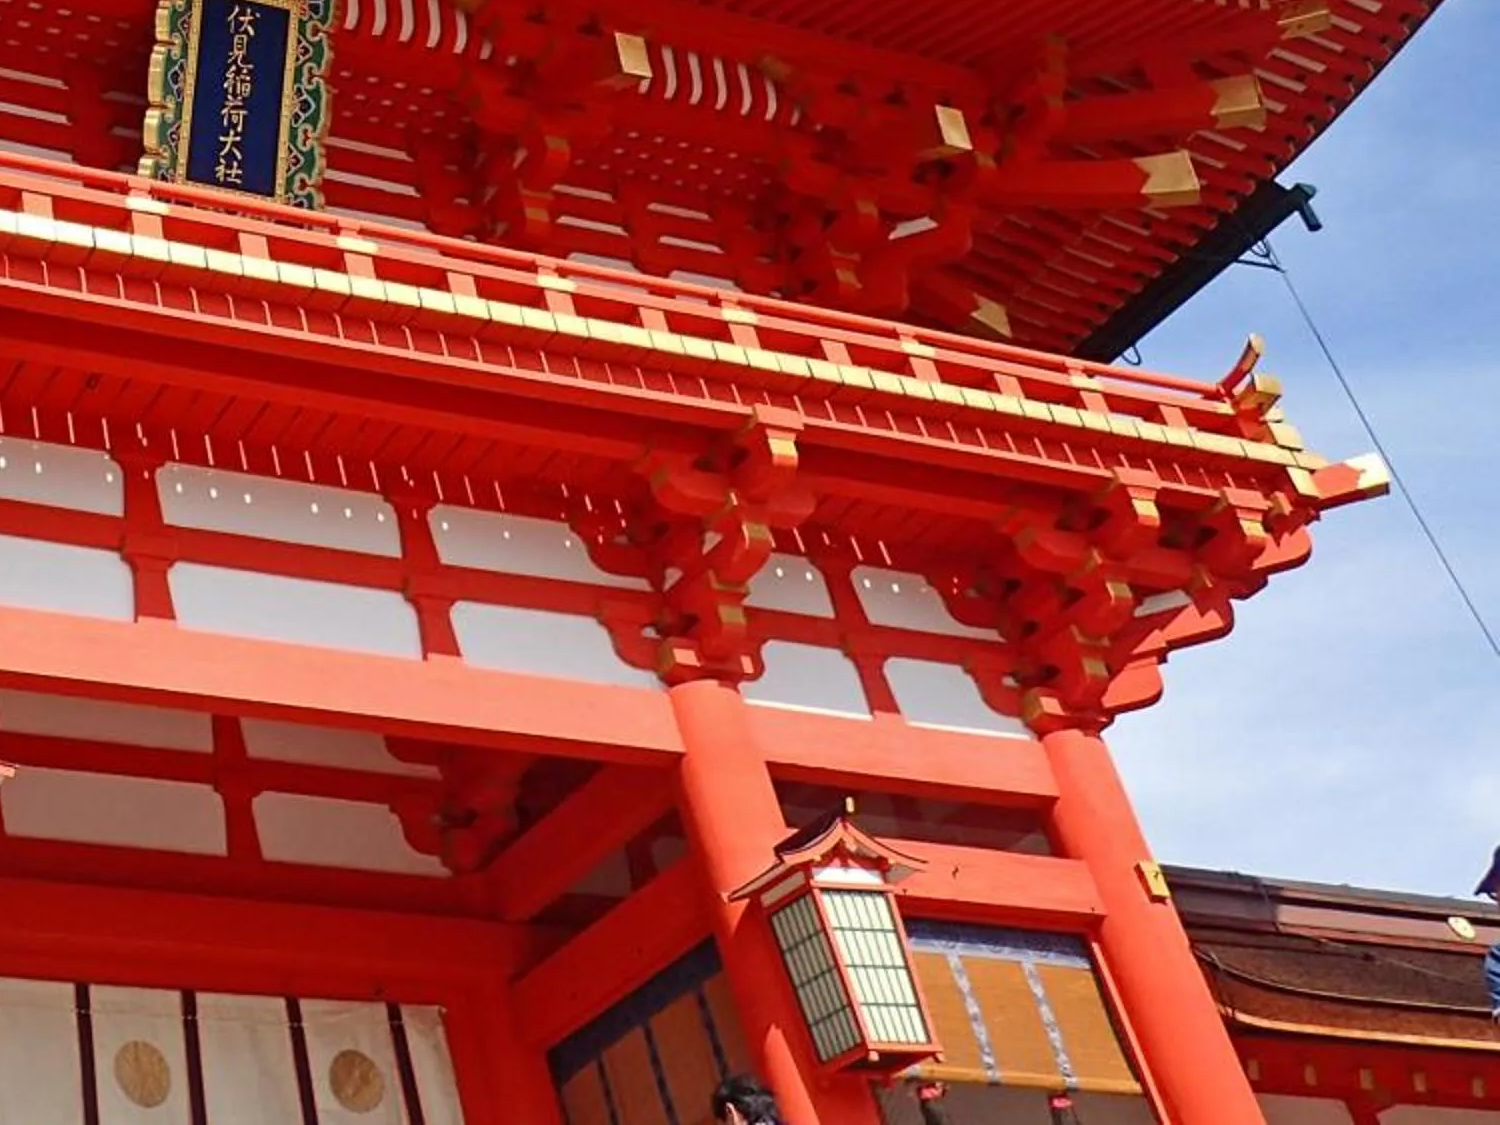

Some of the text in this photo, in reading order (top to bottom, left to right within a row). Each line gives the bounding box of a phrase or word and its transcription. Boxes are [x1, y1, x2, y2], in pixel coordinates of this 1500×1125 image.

[213, 4, 262, 185] 伏見稲荷大社
